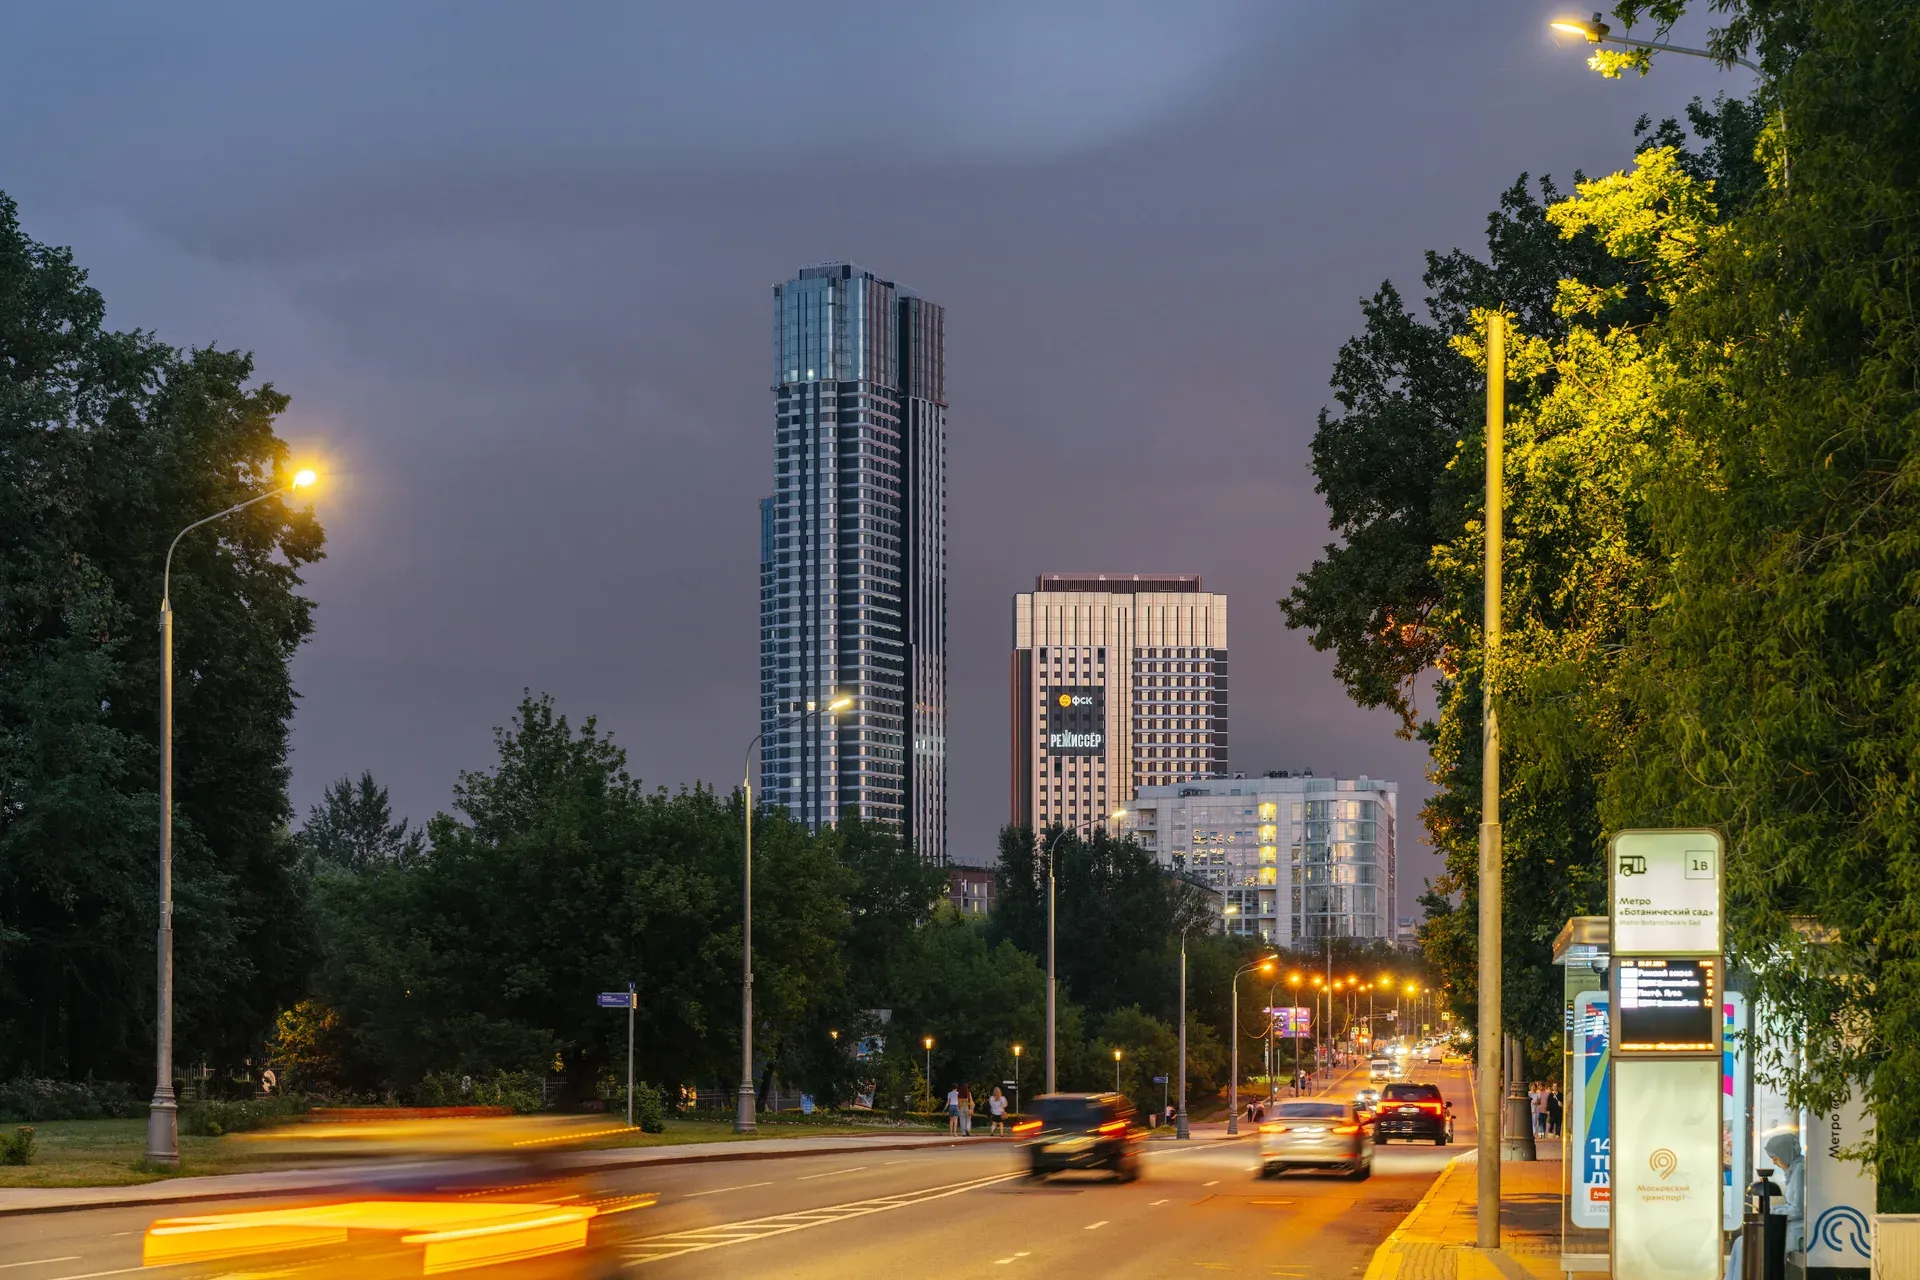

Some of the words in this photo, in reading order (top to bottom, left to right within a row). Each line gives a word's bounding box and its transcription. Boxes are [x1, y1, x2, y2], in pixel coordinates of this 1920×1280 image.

[1072, 695, 1092, 706] ФСК
[1050, 730, 1102, 748] РЕЖИССЁР
[1619, 898, 1652, 907] Метро
[1619, 908, 1690, 916] «Ботанический
[1692, 909, 1714, 917] сад»
[1703, 999, 1714, 1007] 12
[1828, 1114, 1842, 1159] Метро
